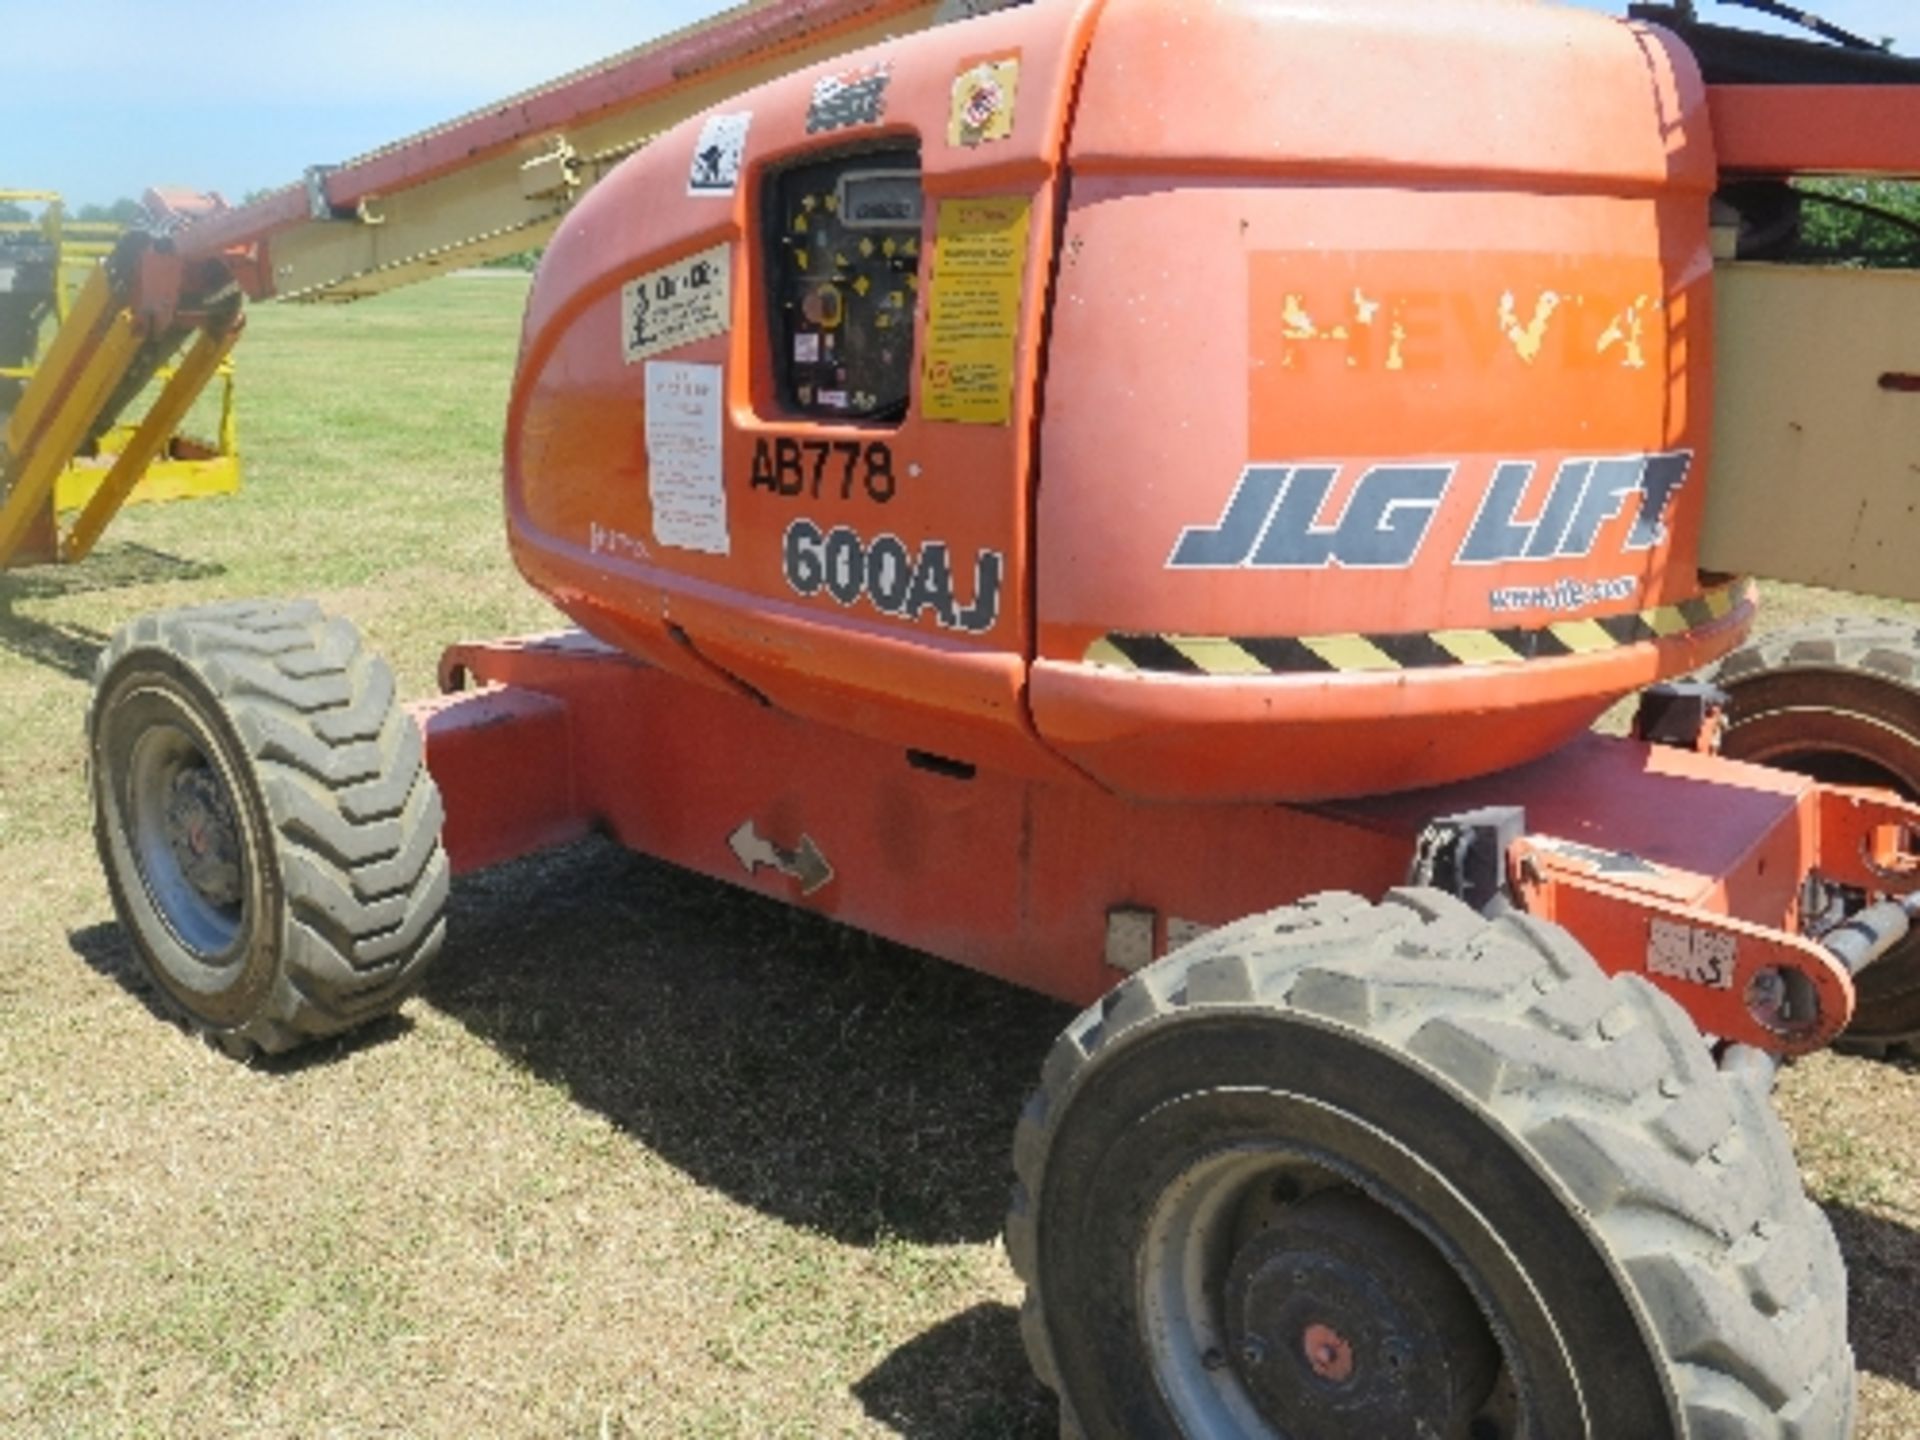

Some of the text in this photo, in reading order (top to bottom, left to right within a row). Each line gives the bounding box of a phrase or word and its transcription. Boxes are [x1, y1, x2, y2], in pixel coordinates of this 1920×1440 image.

[750, 437, 896, 503] AB778
[1164, 449, 1694, 569] JLG LIFT
[782, 517, 1004, 633] 600AJ
